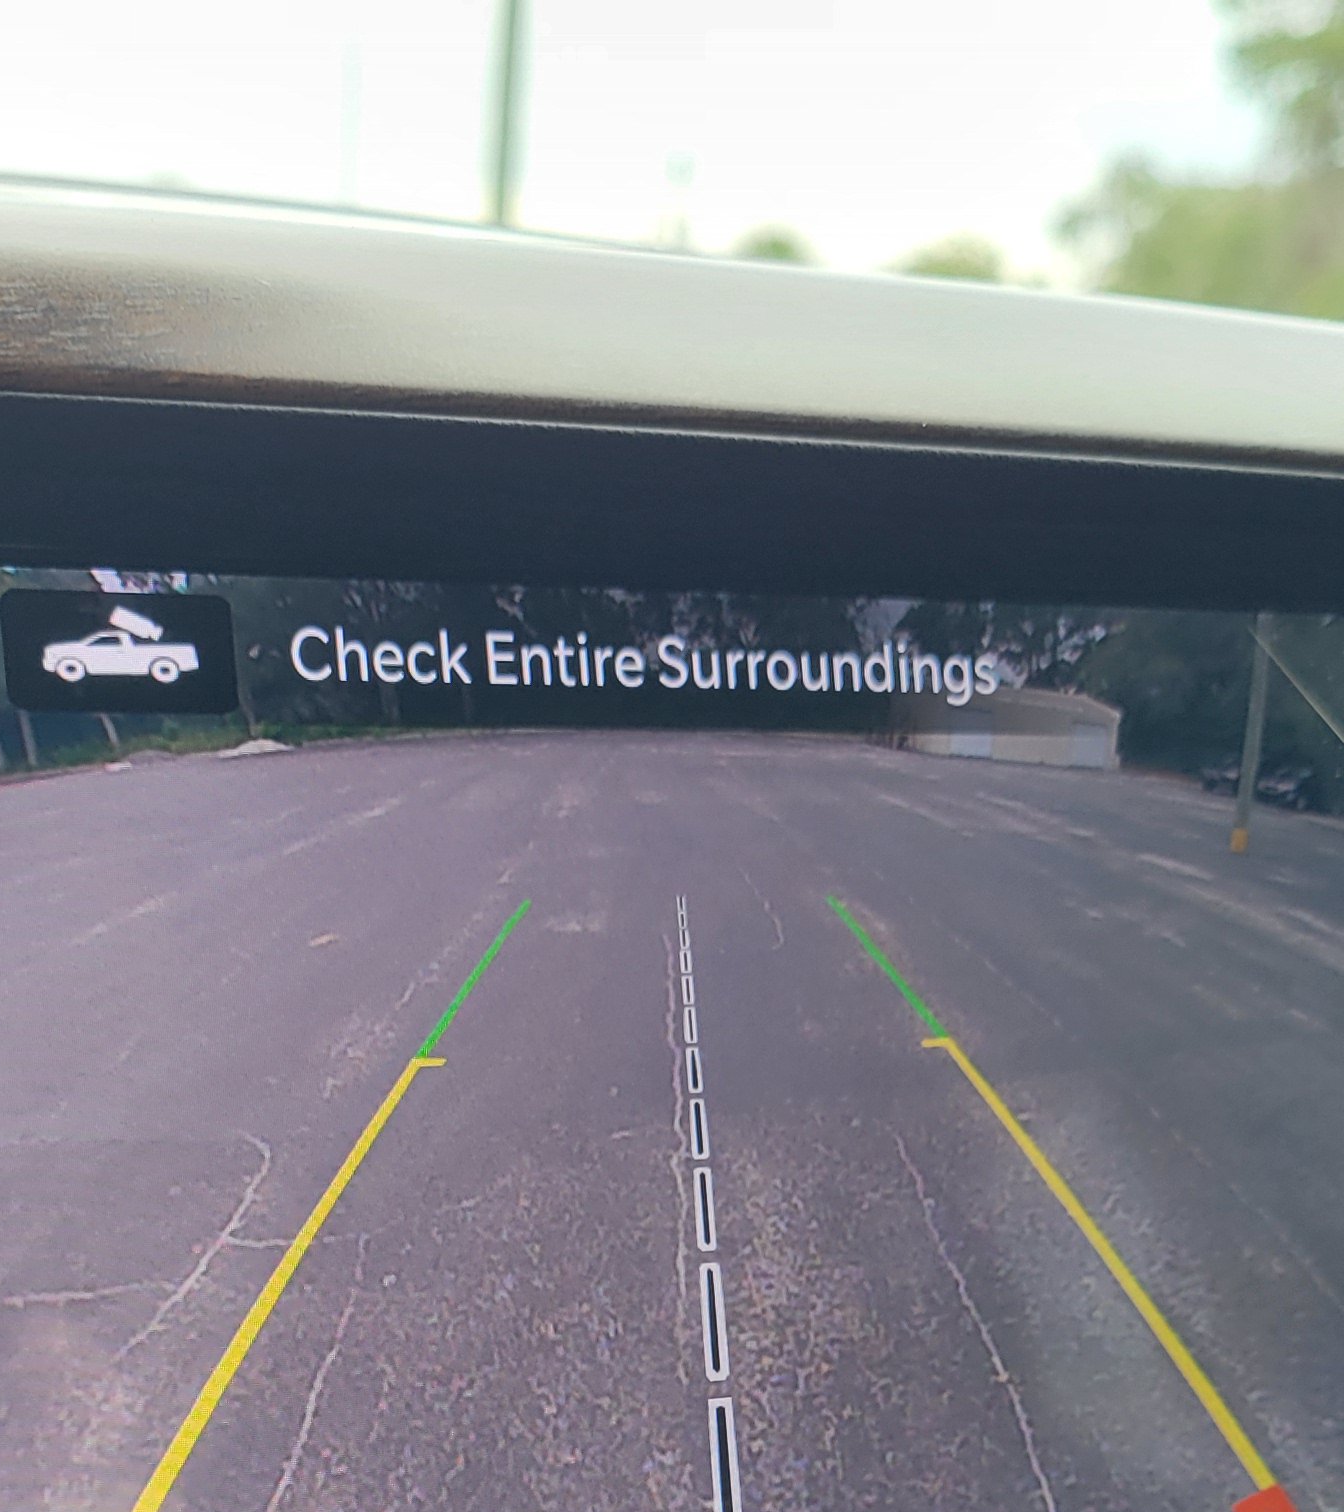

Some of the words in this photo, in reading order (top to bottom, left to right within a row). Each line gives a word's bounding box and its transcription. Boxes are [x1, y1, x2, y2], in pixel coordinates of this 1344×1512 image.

[290, 623, 472, 685] Check
[484, 630, 646, 688] Entire
[657, 635, 1000, 706] Surroundings
